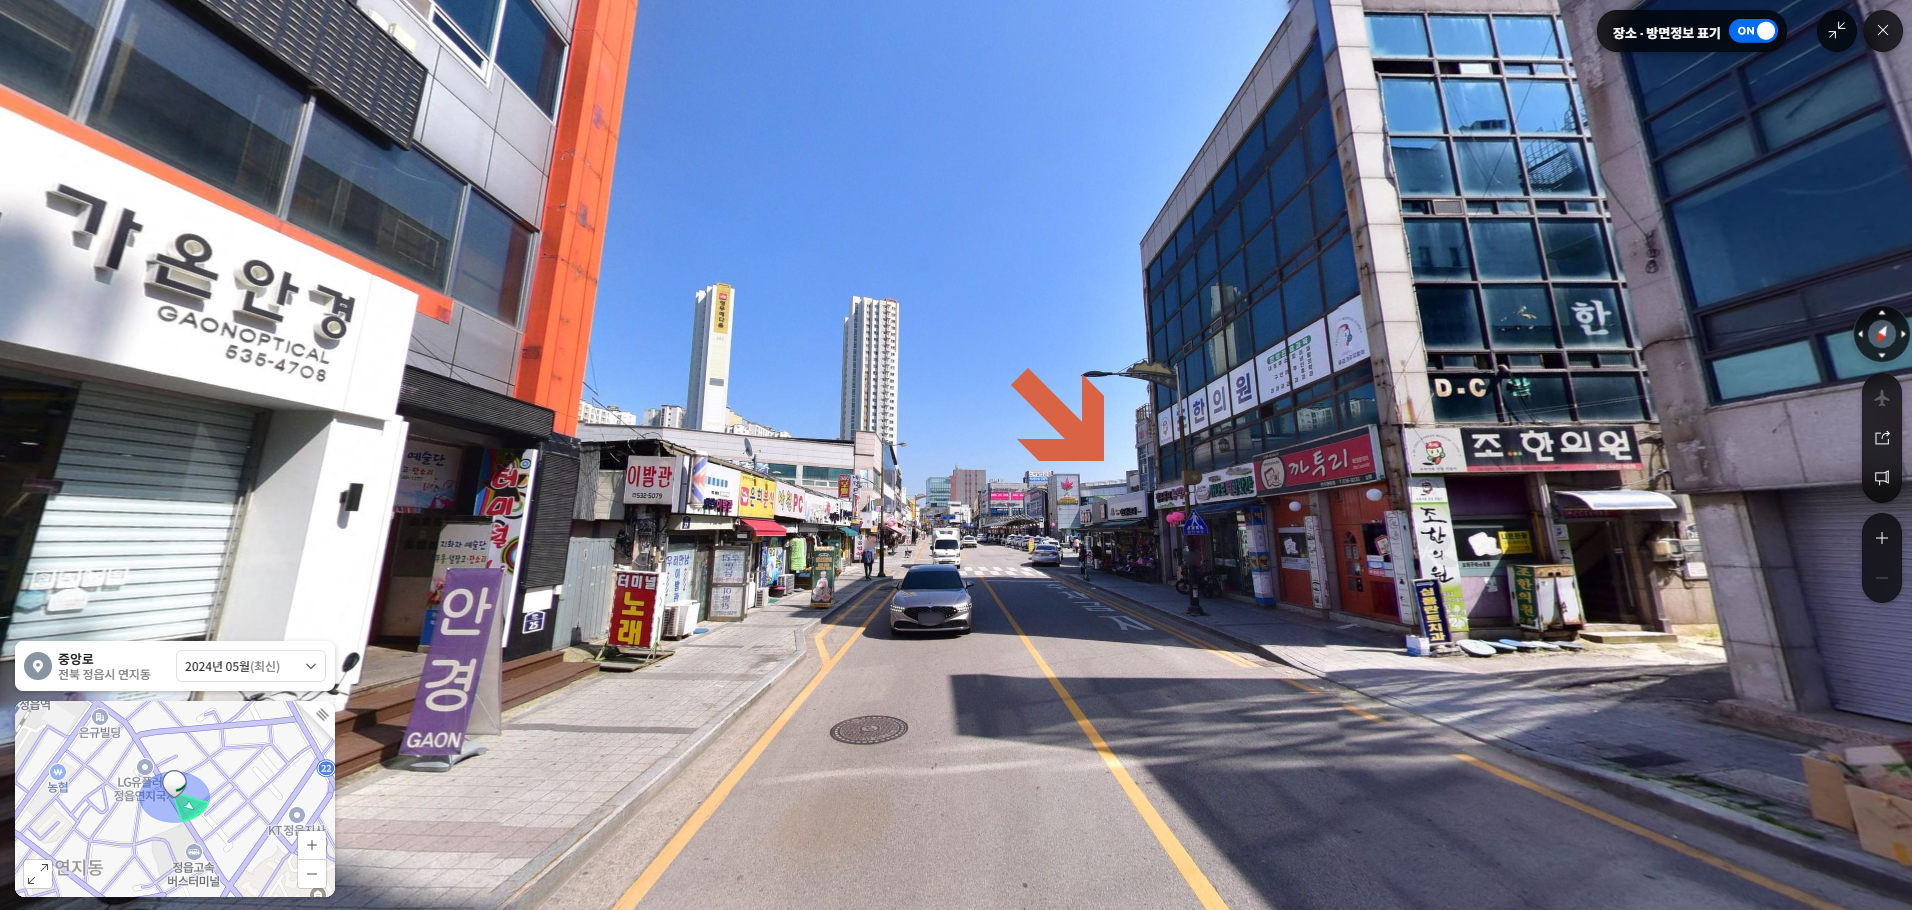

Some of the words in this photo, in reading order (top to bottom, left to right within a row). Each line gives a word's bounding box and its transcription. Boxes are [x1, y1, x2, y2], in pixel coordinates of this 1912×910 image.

[48, 183, 357, 345] 가온안경
[1571, 300, 1612, 336] 한
[157, 305, 330, 365] GAONOPTICAL
[225, 344, 327, 383] 535-4708
[406, 450, 446, 467] 예술단
[1471, 433, 1504, 458] 조
[1520, 429, 1633, 463] 한의원
[627, 464, 672, 489] 이발관
[1287, 448, 1348, 476] 까투리
[749, 487, 775, 509] 은희분식
[440, 540, 462, 549] 지화자
[464, 540, 487, 550] 예술단
[1420, 506, 1455, 583] 조한의원
[617, 573, 657, 591] 터미널
[528, 620, 539, 630] 25
[616, 591, 645, 646] 노래
[424, 586, 493, 713] 안경
[406, 731, 463, 749] GAON
